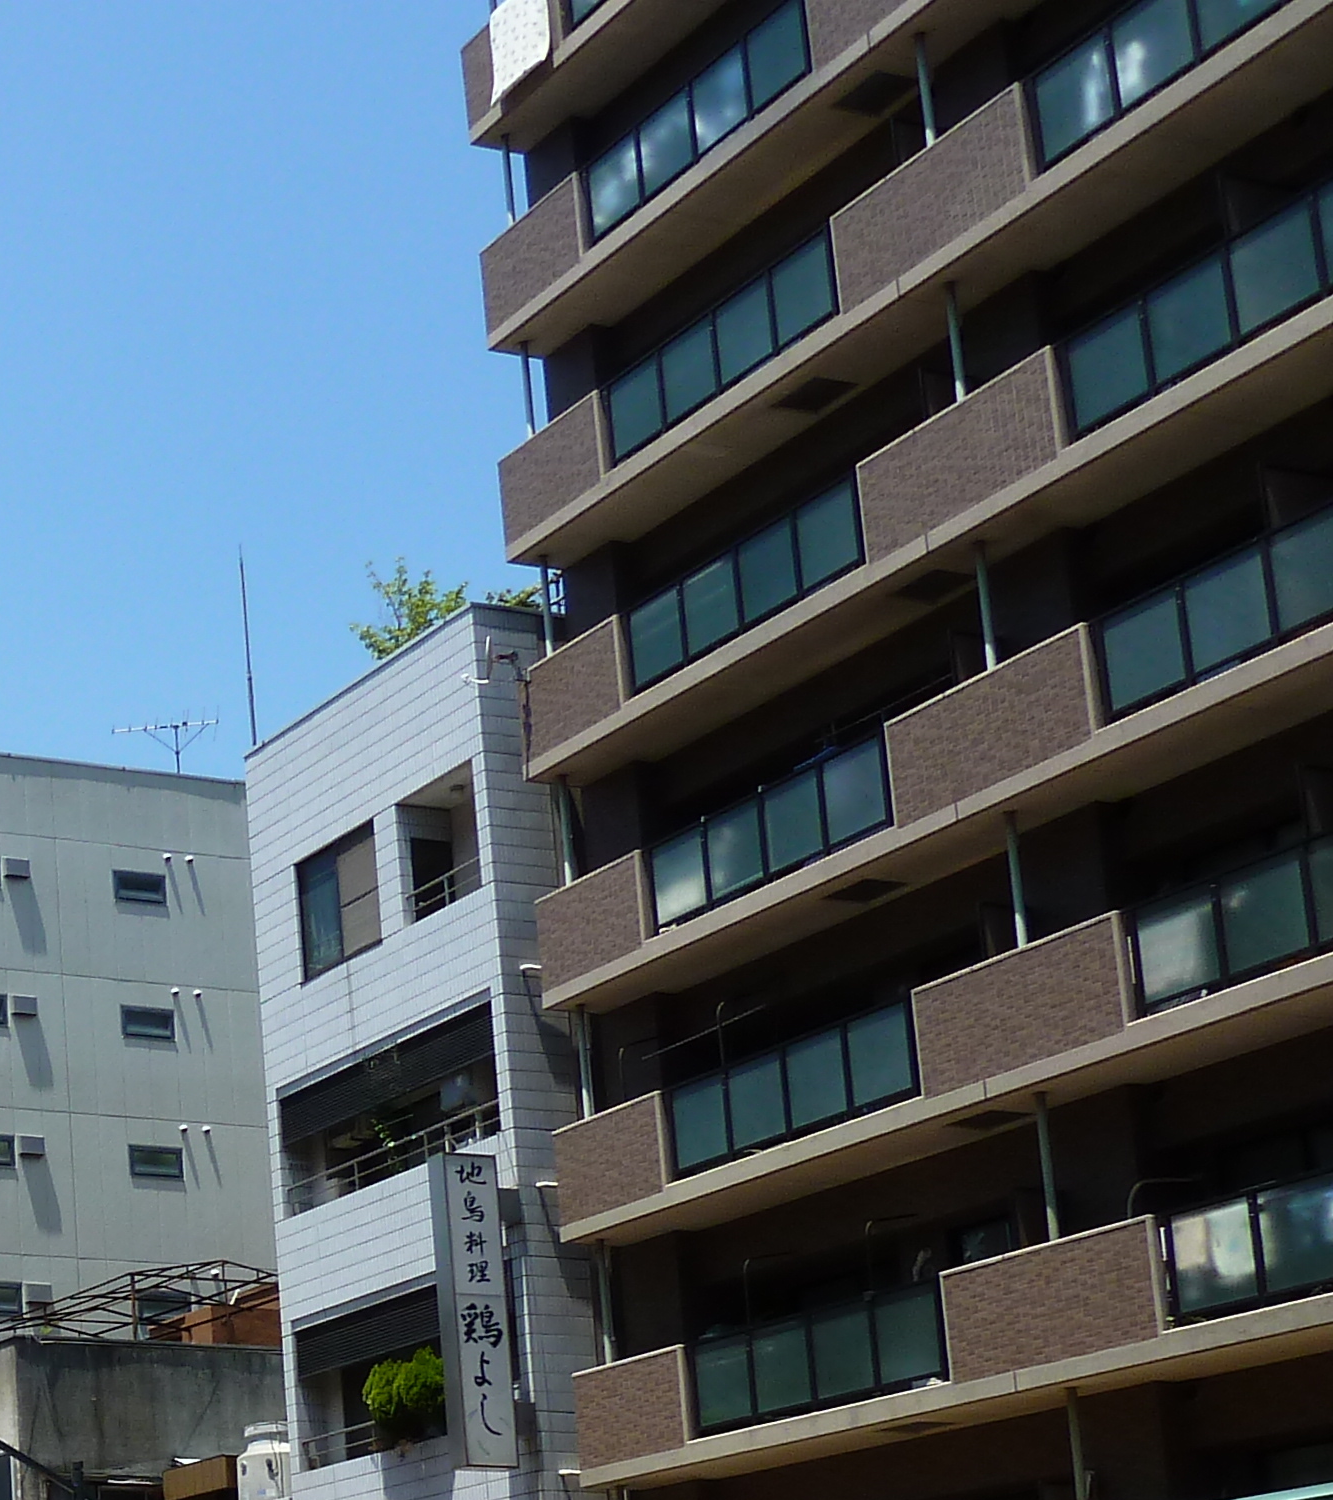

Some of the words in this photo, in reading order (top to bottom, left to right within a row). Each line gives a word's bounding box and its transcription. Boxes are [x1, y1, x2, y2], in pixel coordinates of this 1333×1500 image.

[454, 1161, 491, 1284] 地鳥料理
[459, 1302, 504, 1437] 鶏よし
